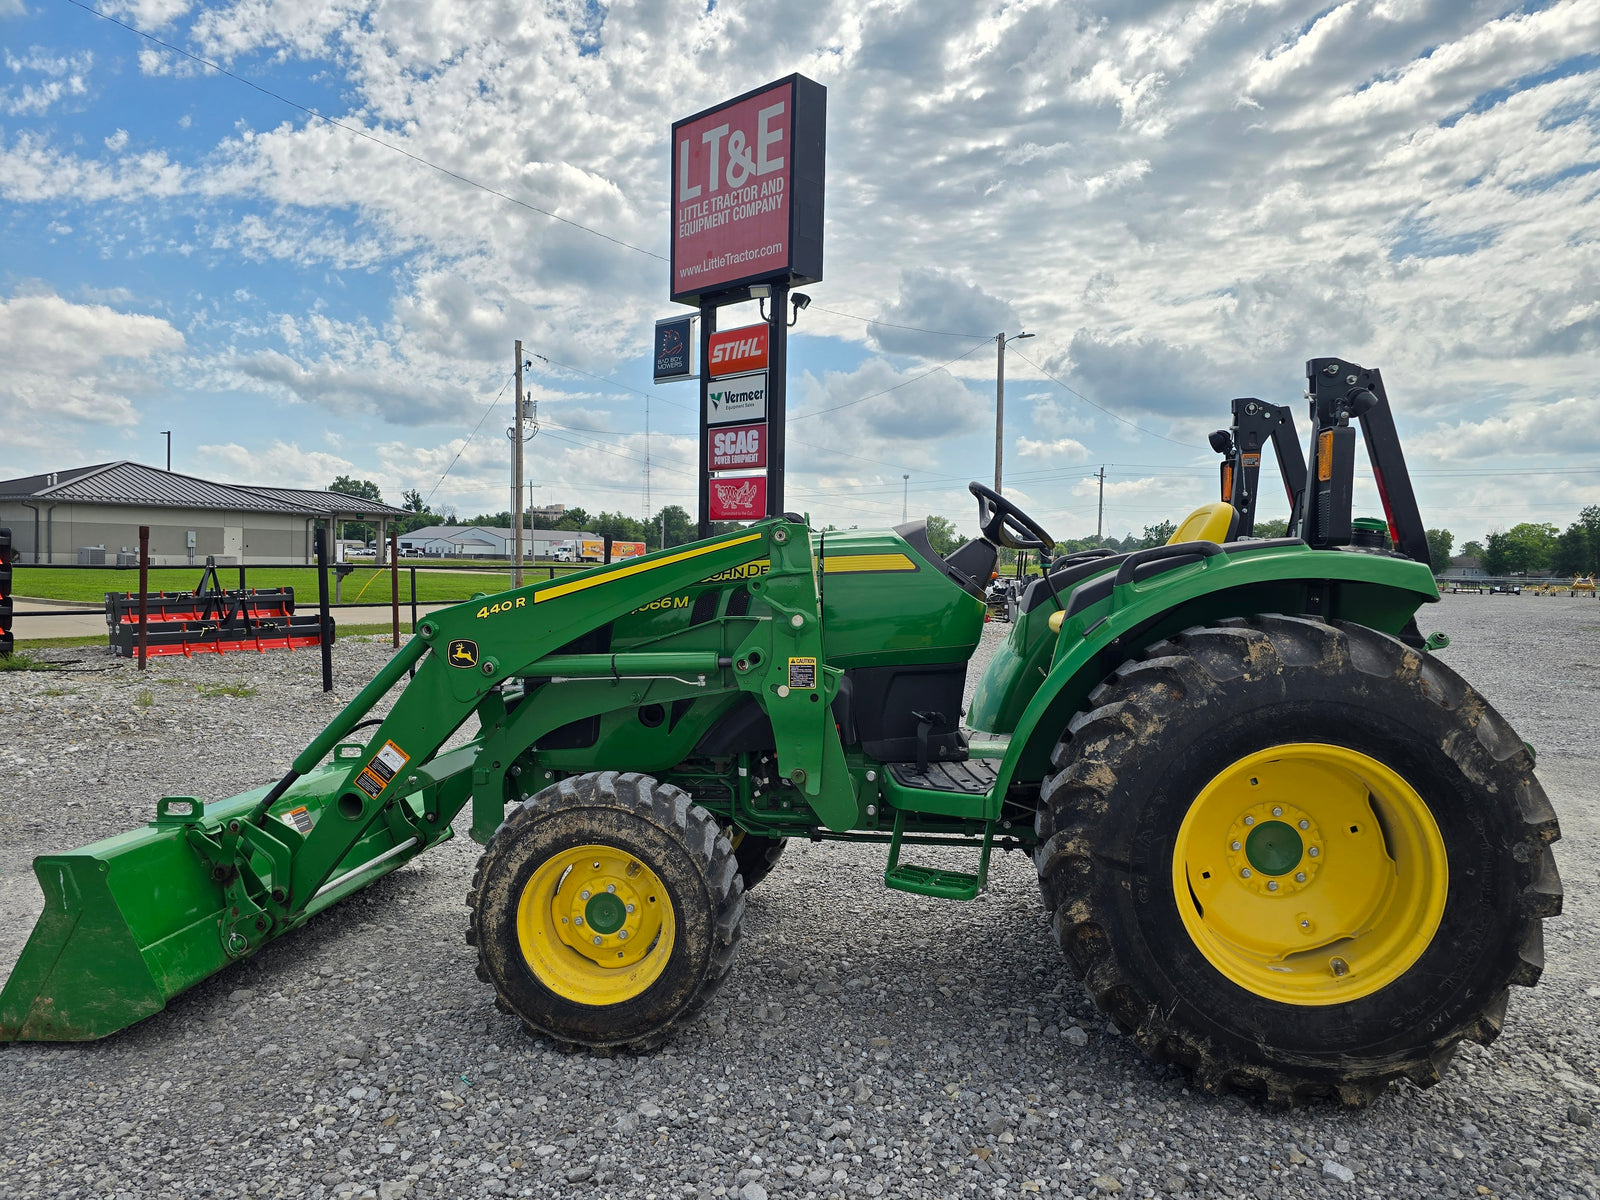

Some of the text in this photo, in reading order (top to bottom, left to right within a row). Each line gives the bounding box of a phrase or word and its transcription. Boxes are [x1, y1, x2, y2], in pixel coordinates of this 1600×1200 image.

[680, 101, 785, 203] LT&E
[679, 177, 785, 224] LITTLE TRACTOR AND
[679, 194, 784, 239] EQUIPMENT COMPANY
[679, 242, 783, 278] www.LittleTractor.com
[711, 337, 762, 363] STIHL
[724, 390, 764, 404] Vermeer
[714, 429, 759, 456] SCAG
[714, 453, 759, 465] POWER EQUIPMENT
[476, 597, 526, 619] 440 R
[673, 595, 690, 609] M
